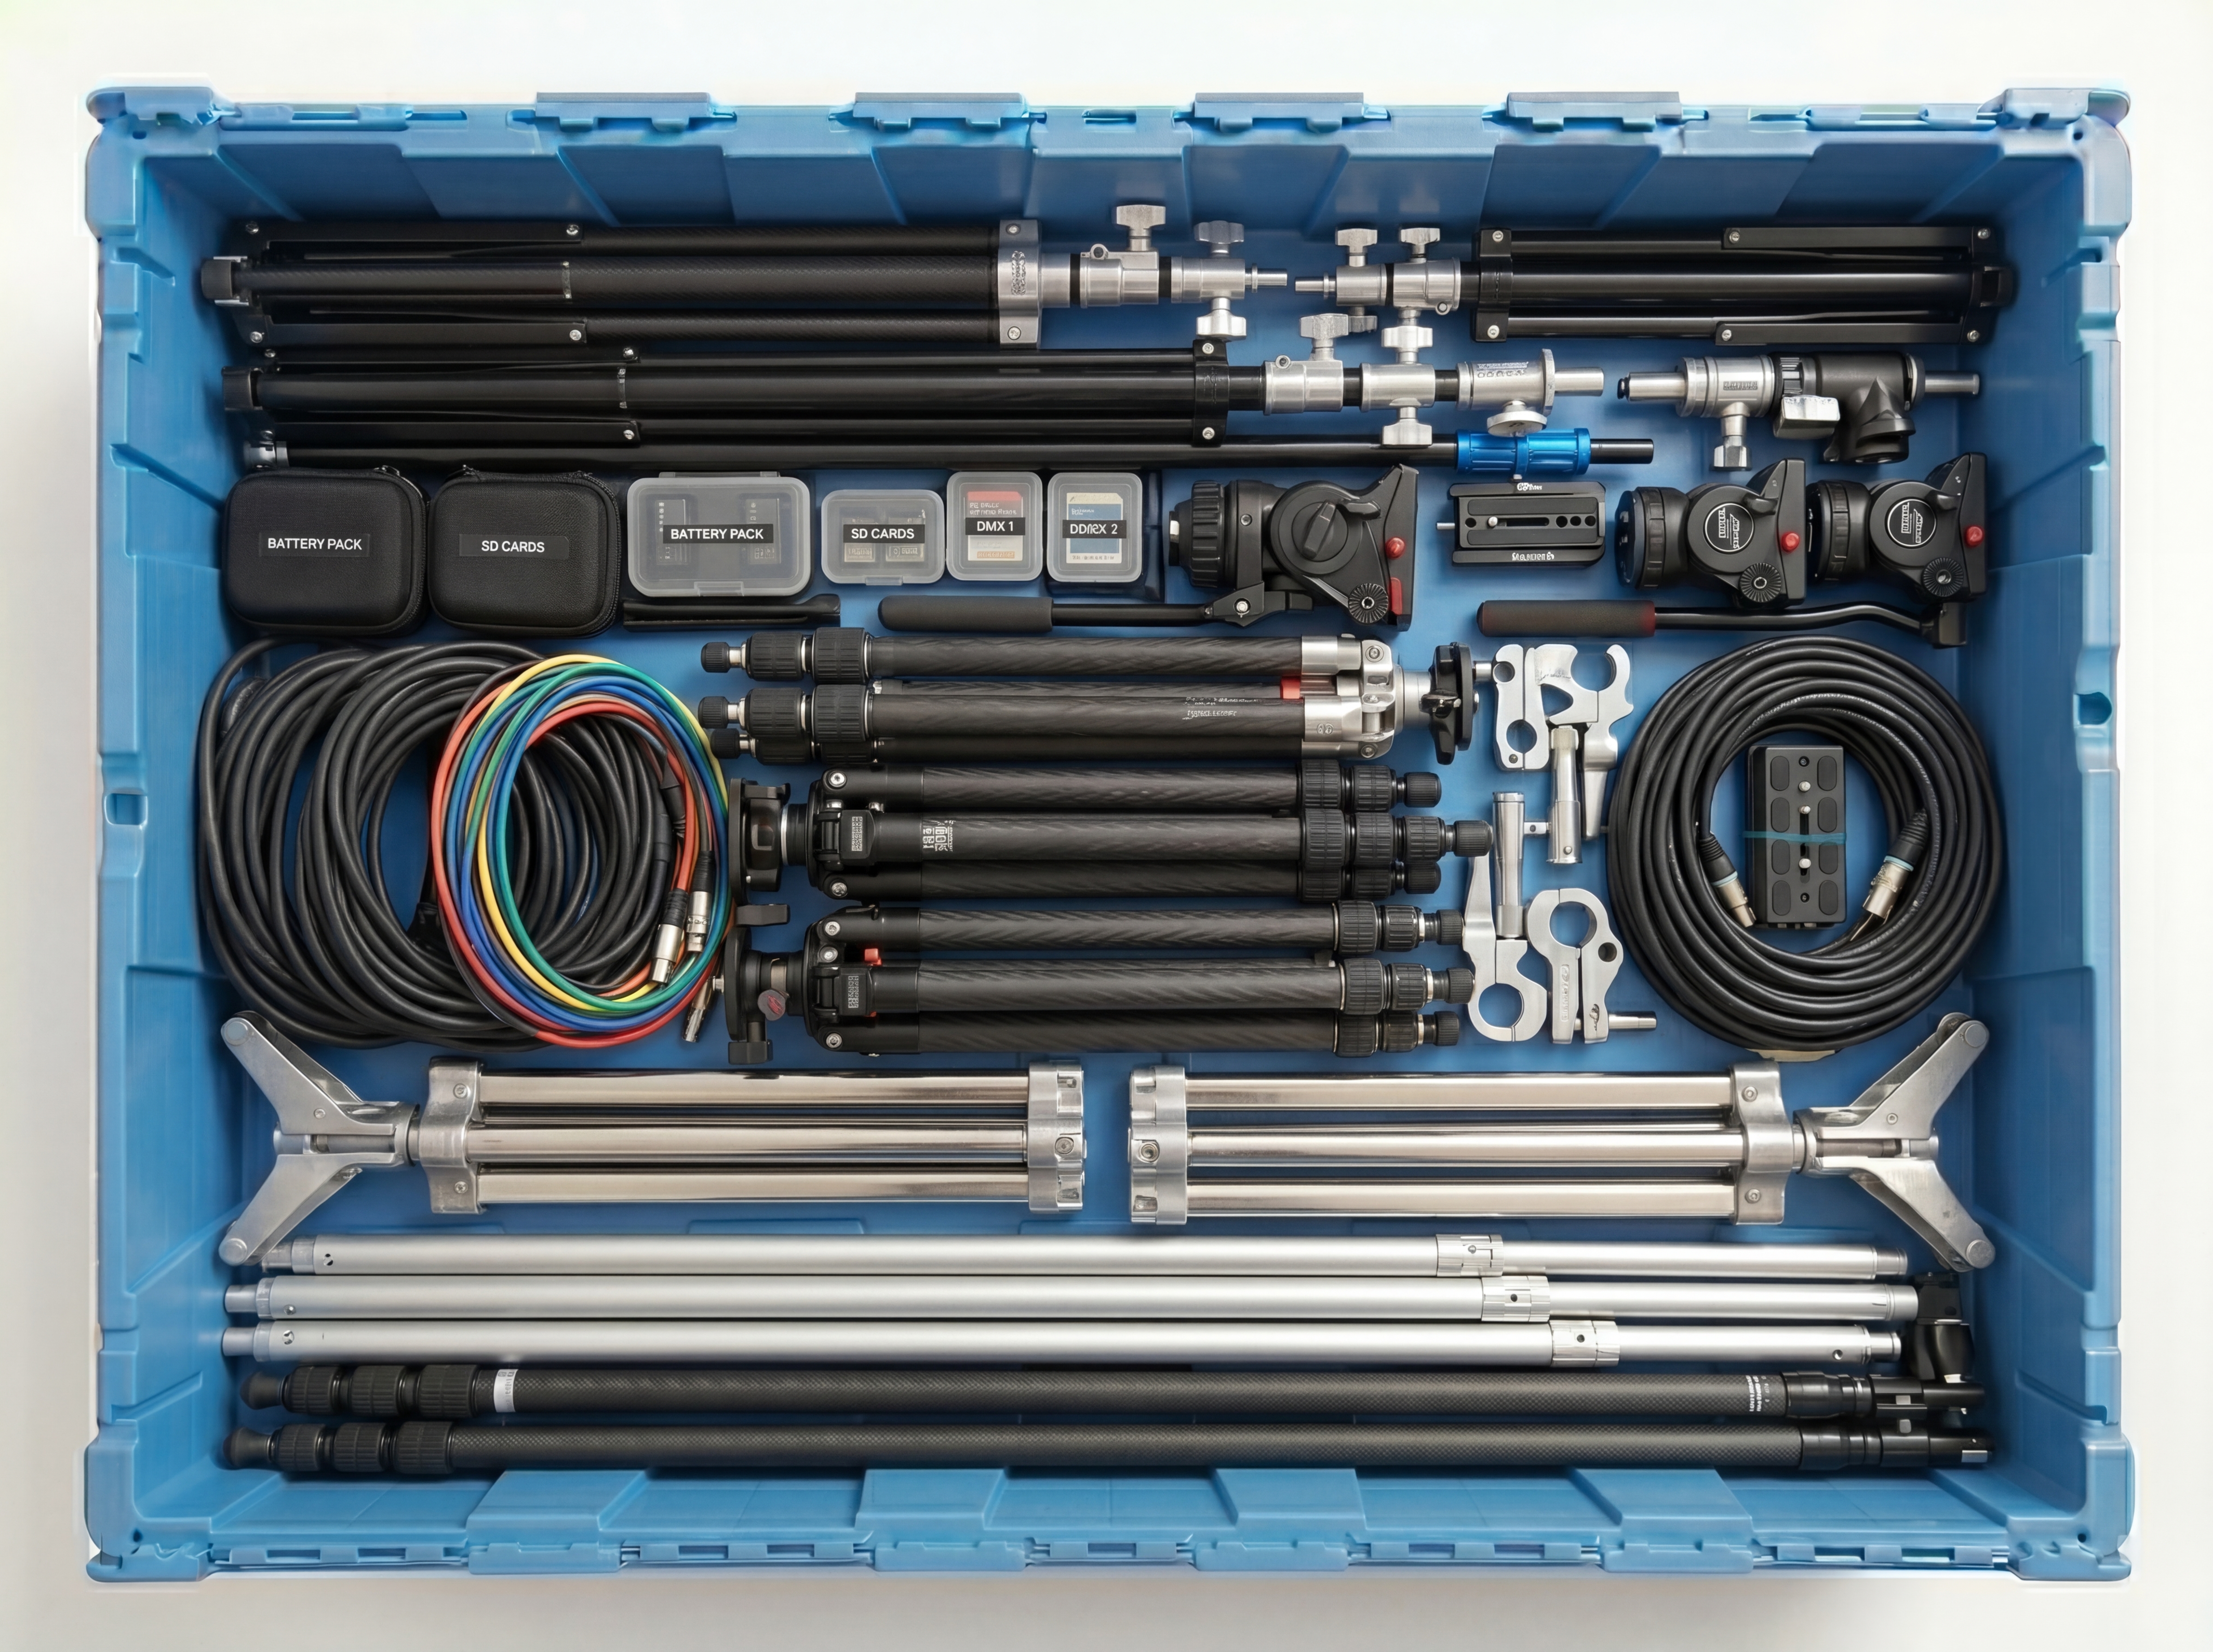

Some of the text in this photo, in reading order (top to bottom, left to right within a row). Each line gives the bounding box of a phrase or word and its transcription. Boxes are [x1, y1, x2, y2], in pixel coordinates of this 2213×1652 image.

[977, 521, 1013, 531] DMX 1
[1111, 523, 1118, 534] 2
[671, 528, 764, 539] BATTERY PACK
[851, 528, 915, 539] SD CARDS
[267, 537, 362, 550] BATTERY PACK
[481, 540, 545, 553] SD CARDS
